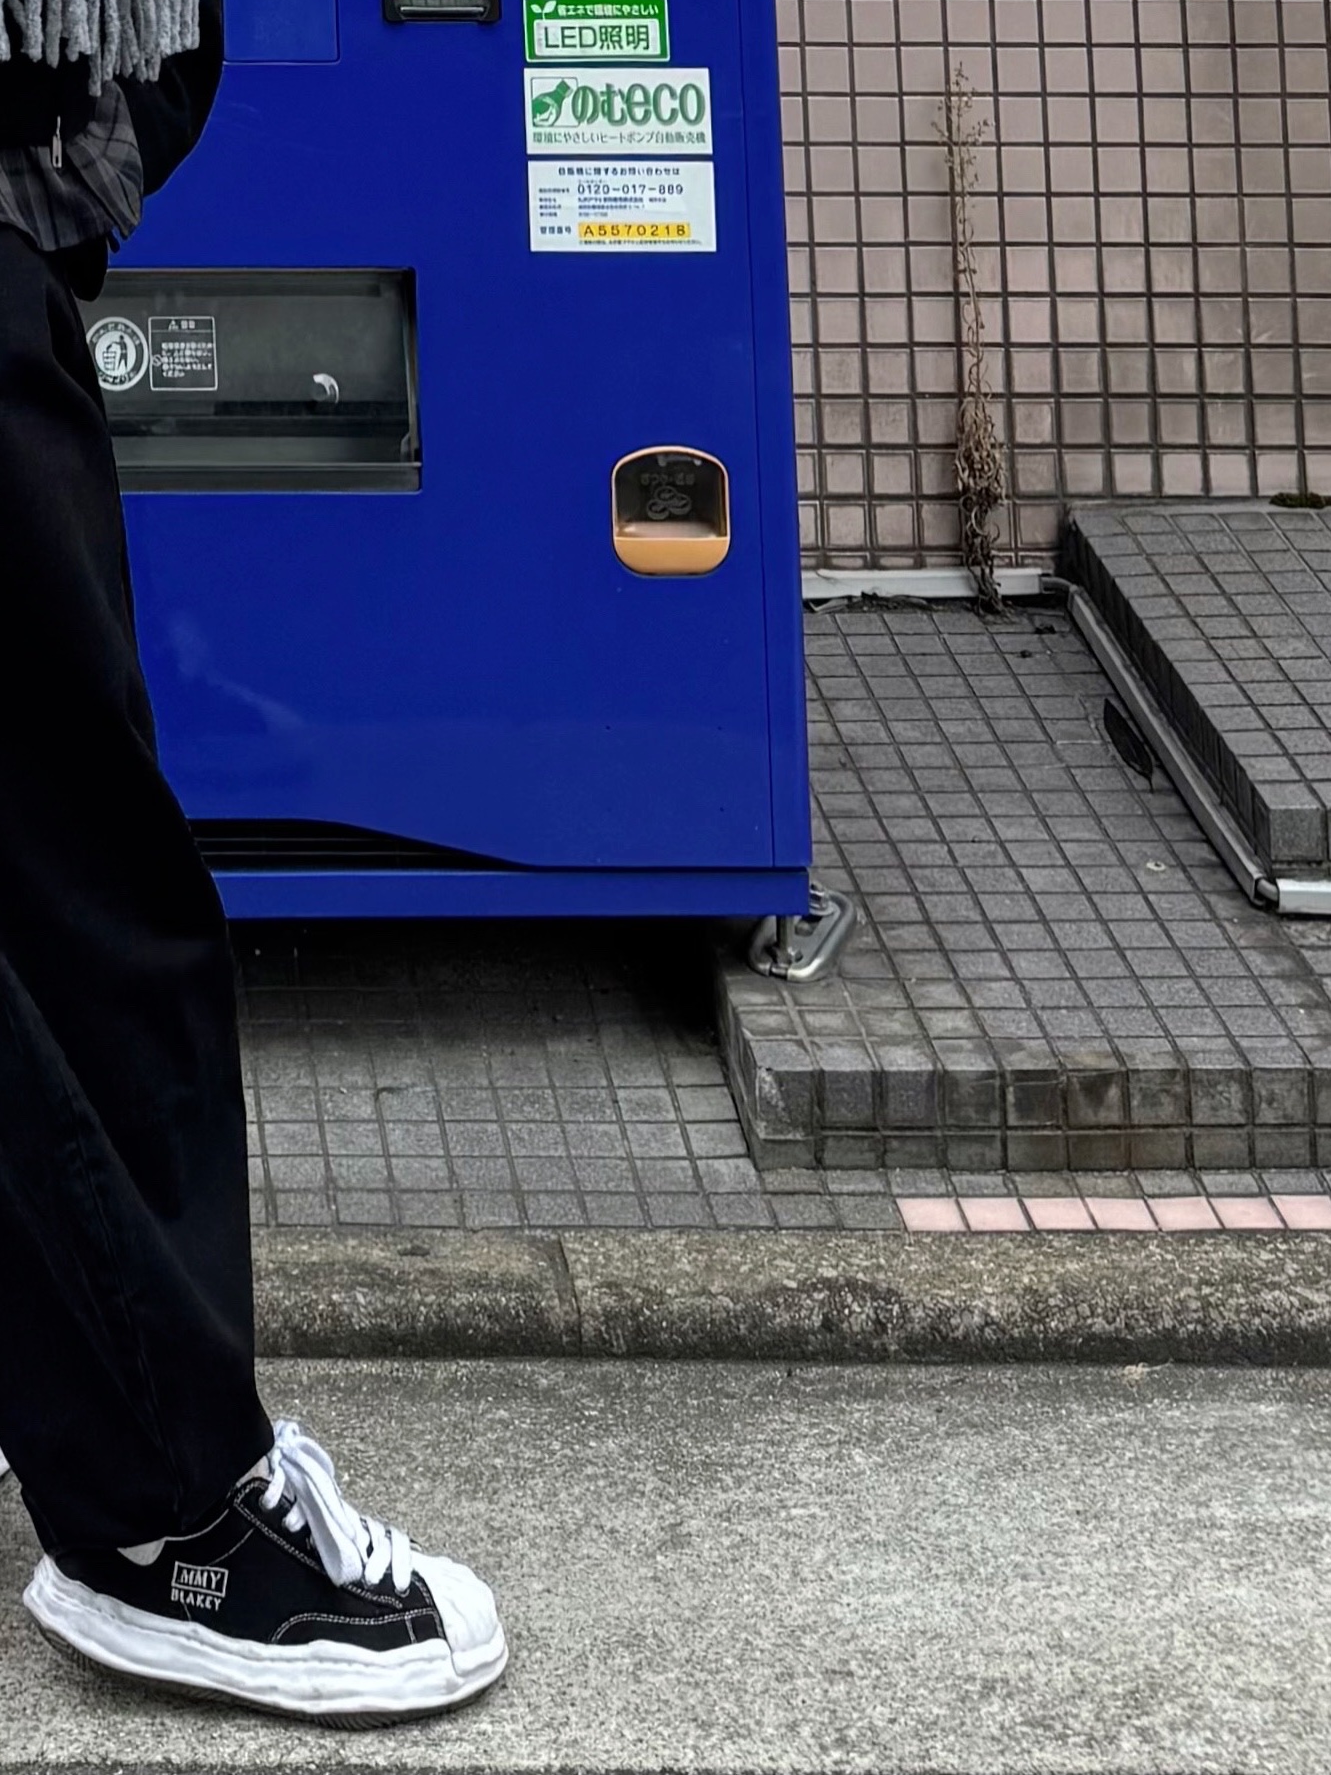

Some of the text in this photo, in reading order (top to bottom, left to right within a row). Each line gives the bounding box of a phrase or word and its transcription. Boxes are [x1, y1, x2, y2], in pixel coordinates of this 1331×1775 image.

[544, 24, 650, 50] LED照明
[571, 83, 706, 126] のむeco
[532, 130, 707, 144] 環境にやさしいヒートポンプ自動販売機
[180, 1568, 222, 1590] MMY
[170, 1587, 222, 1611] BLAKEY
